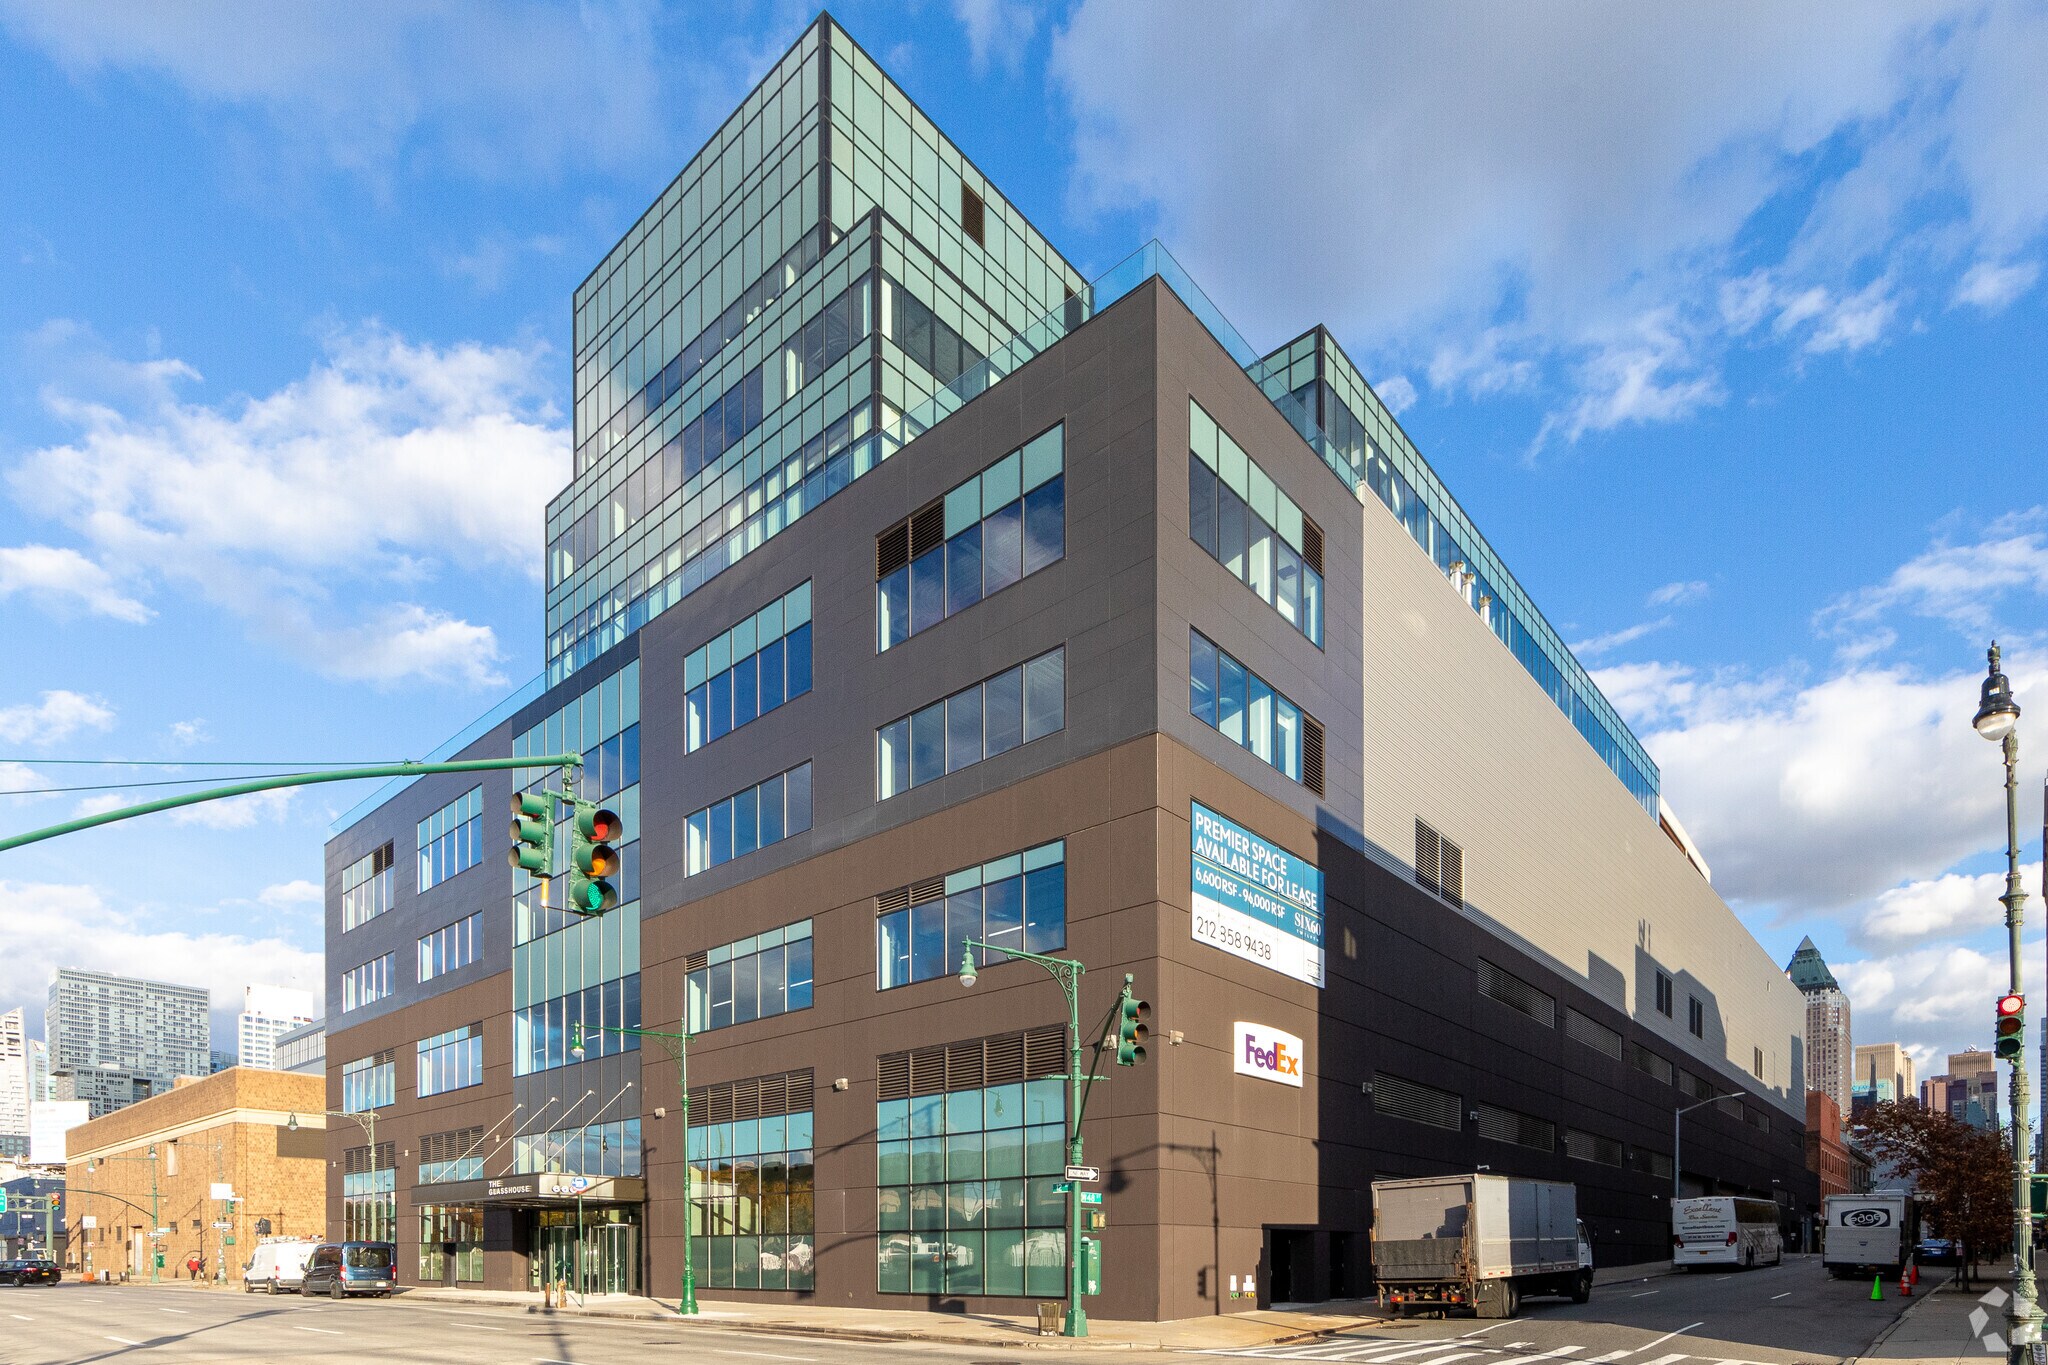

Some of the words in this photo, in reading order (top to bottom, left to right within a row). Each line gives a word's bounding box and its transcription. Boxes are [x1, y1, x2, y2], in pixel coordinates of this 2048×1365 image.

[1195, 812, 1250, 857] PREMIER
[1252, 842, 1287, 876] SPACE
[1195, 835, 1260, 882] AVAILABLE
[1262, 871, 1285, 894] FOR
[1286, 882, 1318, 910] LEASE
[1222, 880, 1237, 896] RSF
[1243, 889, 1271, 914] 96,000
[1271, 905, 1286, 919] RSF
[1197, 916, 1217, 939] 212
[1220, 925, 1242, 949] 358
[1244, 935, 1271, 961] 9438
[1246, 1033, 1299, 1077] FedEx
[488, 1180, 504, 1188] THE
[488, 1185, 533, 1196] GLASSHOUSE
[1683, 1203, 1722, 1215] Excellent
